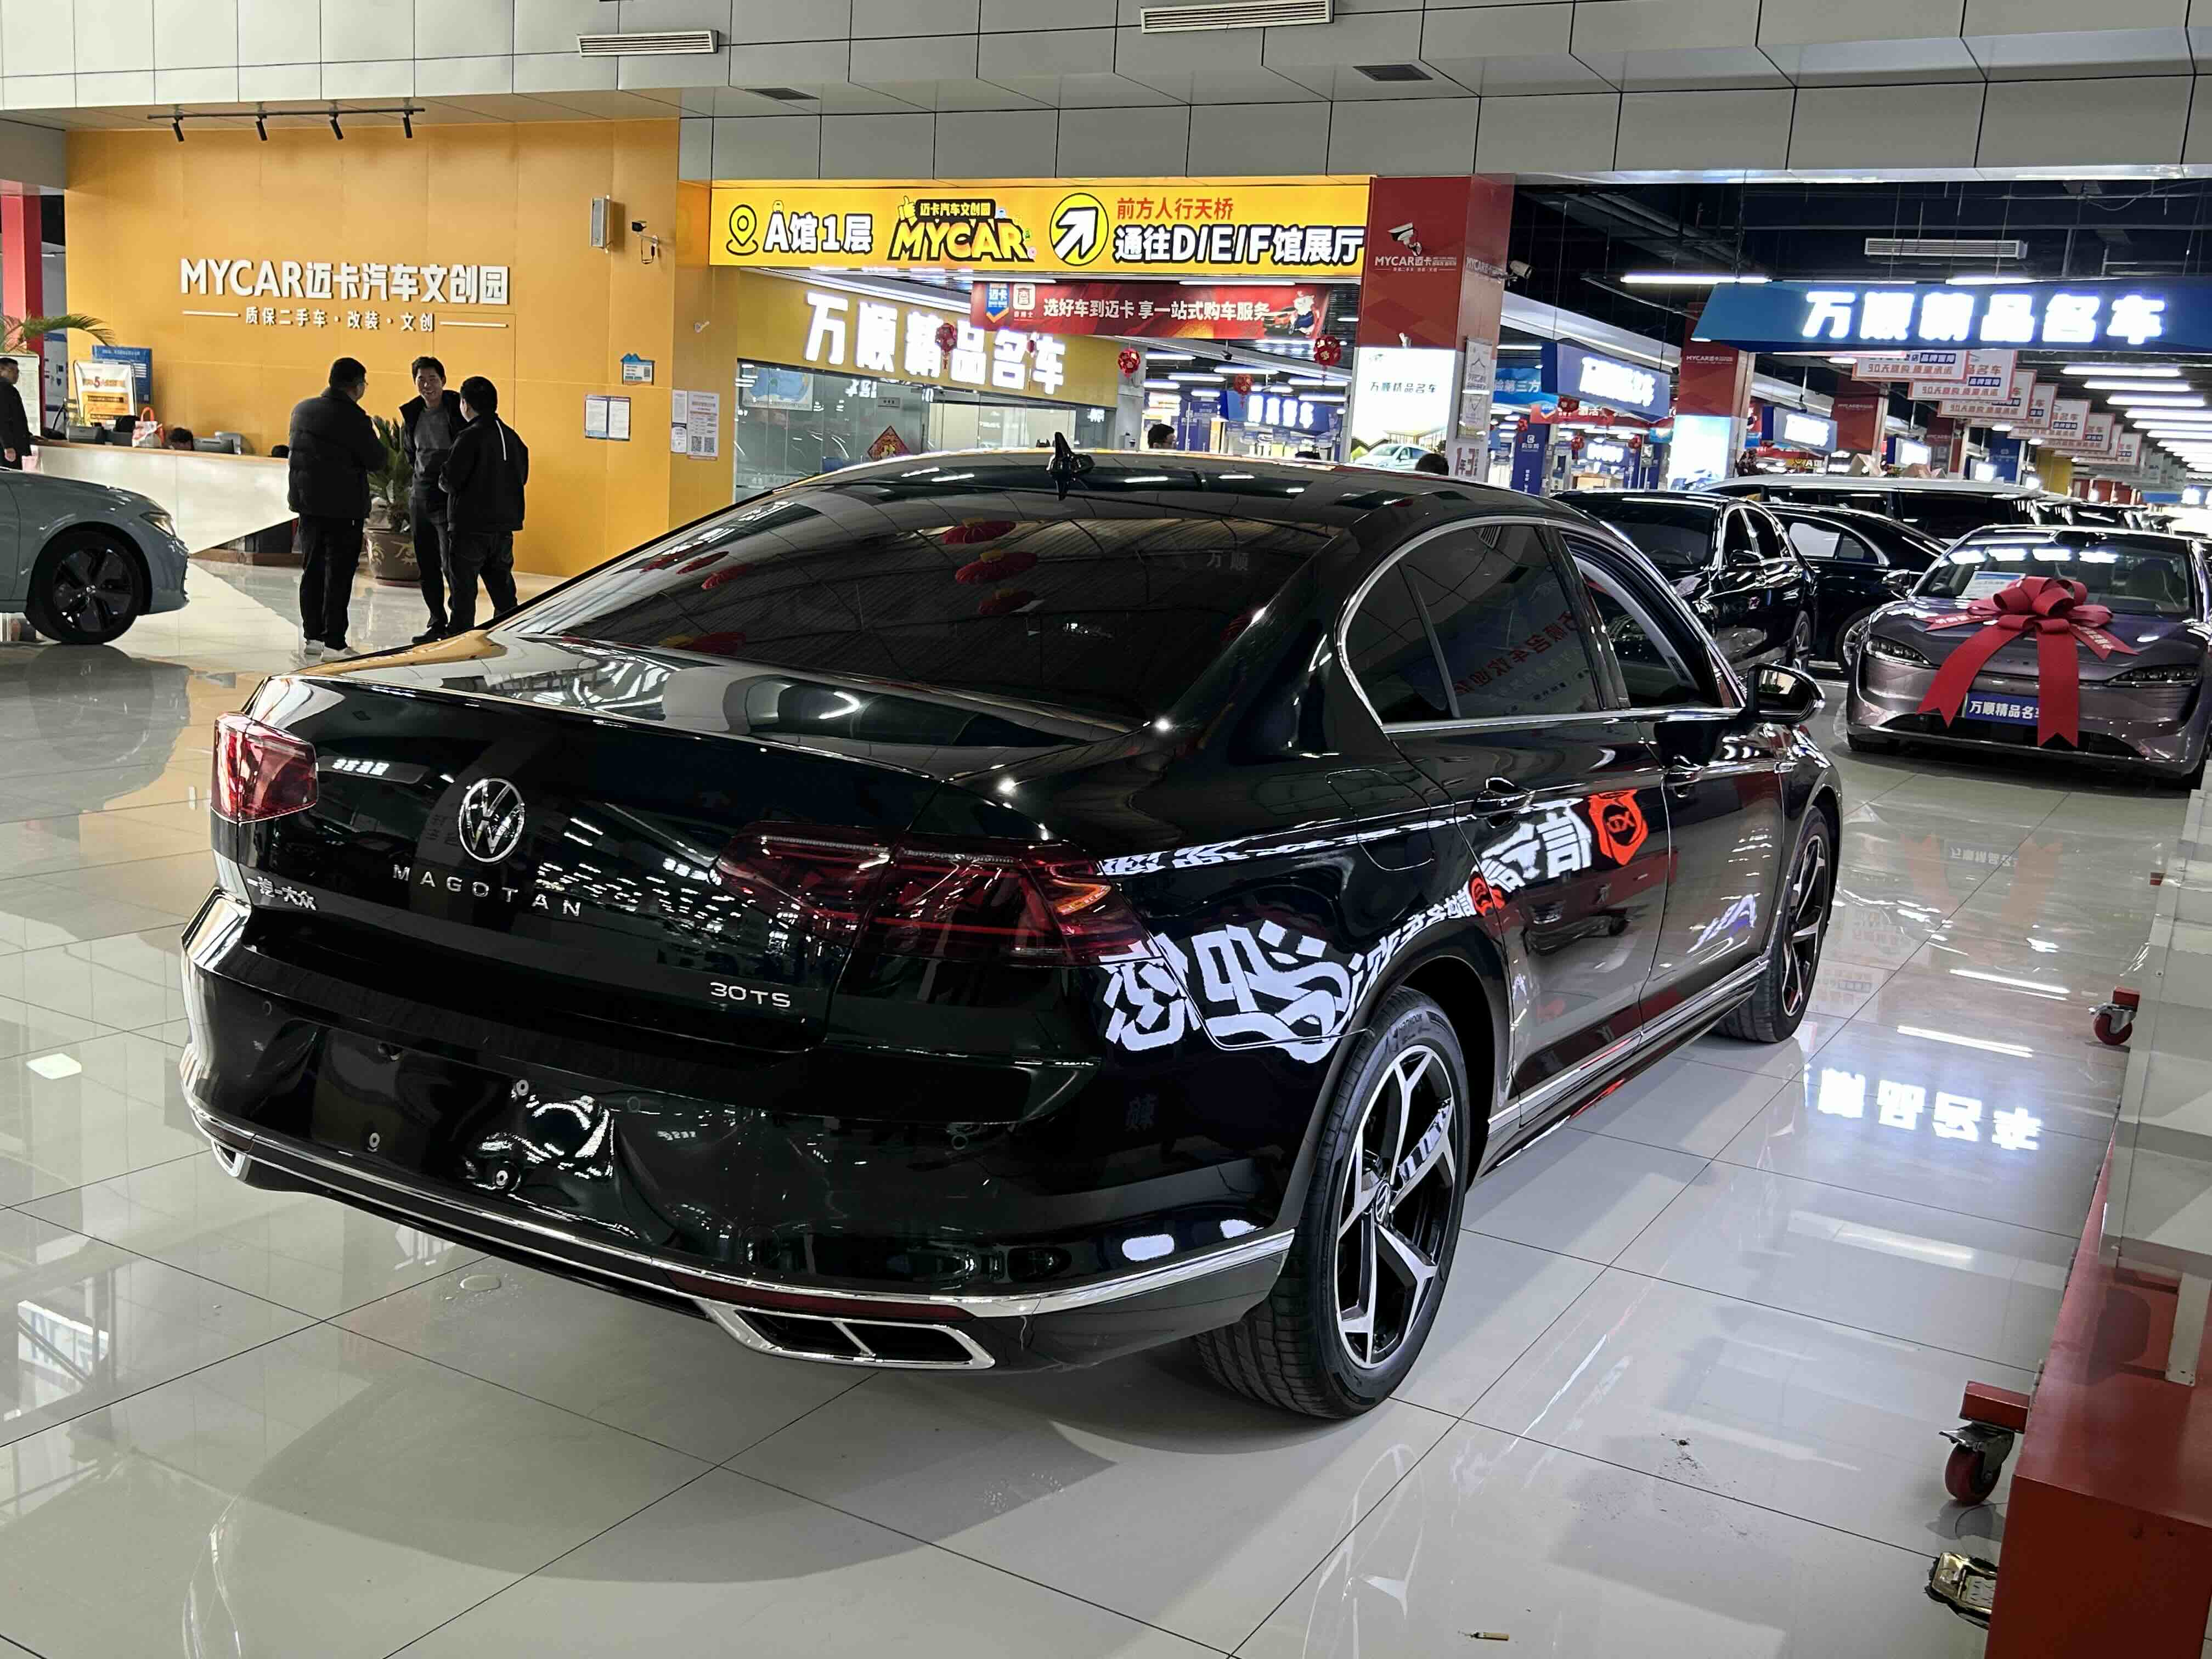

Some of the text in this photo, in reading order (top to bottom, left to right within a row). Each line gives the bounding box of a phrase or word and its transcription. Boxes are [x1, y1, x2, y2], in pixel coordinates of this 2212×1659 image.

[919, 202, 991, 217] 迈卡汽车文创园
[1116, 197, 1234, 220] 前方人行天桥
[763, 211, 873, 254] A馆1层
[888, 219, 1034, 262] MYCAR
[180, 258, 509, 305] MYCAR迈卡汽车文创园
[1043, 298, 1271, 321] 选好车到迈卡 享一站式购车服务
[1801, 290, 2166, 345] 万顺精品名车
[1370, 382, 1437, 393] 万顺精品名车
[393, 864, 581, 917] MAGOTAN
